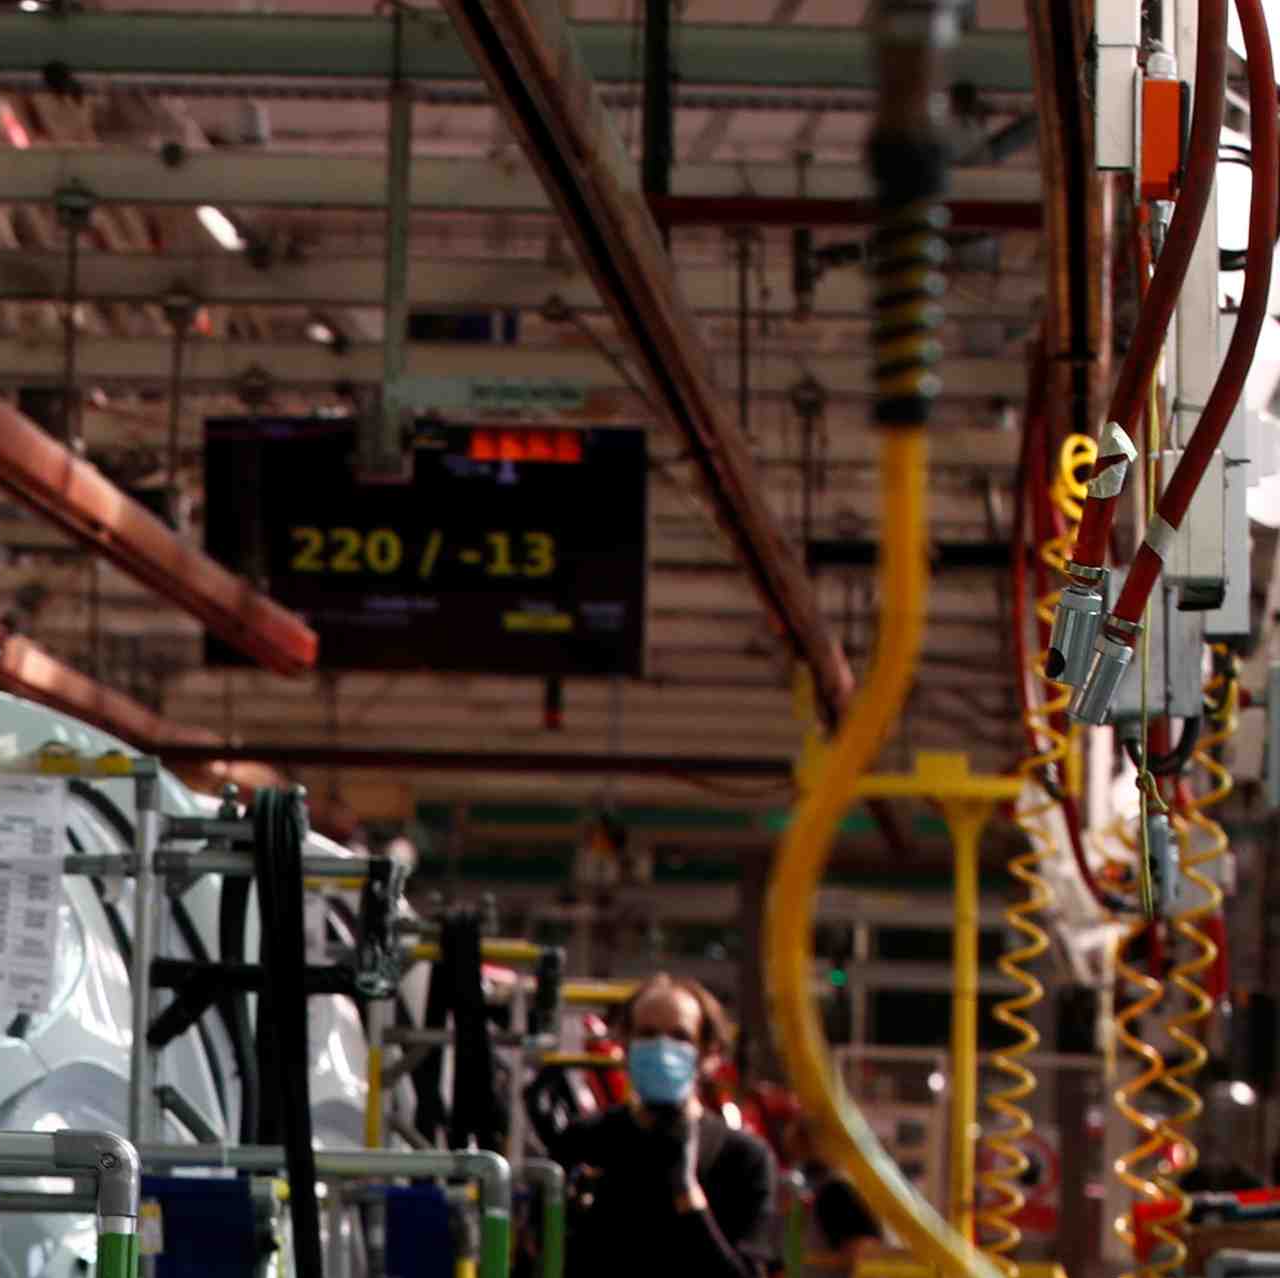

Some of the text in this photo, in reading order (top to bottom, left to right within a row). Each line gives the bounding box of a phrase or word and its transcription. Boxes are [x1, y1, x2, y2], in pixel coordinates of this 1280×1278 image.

[290, 527, 557, 579] 220 / -13
